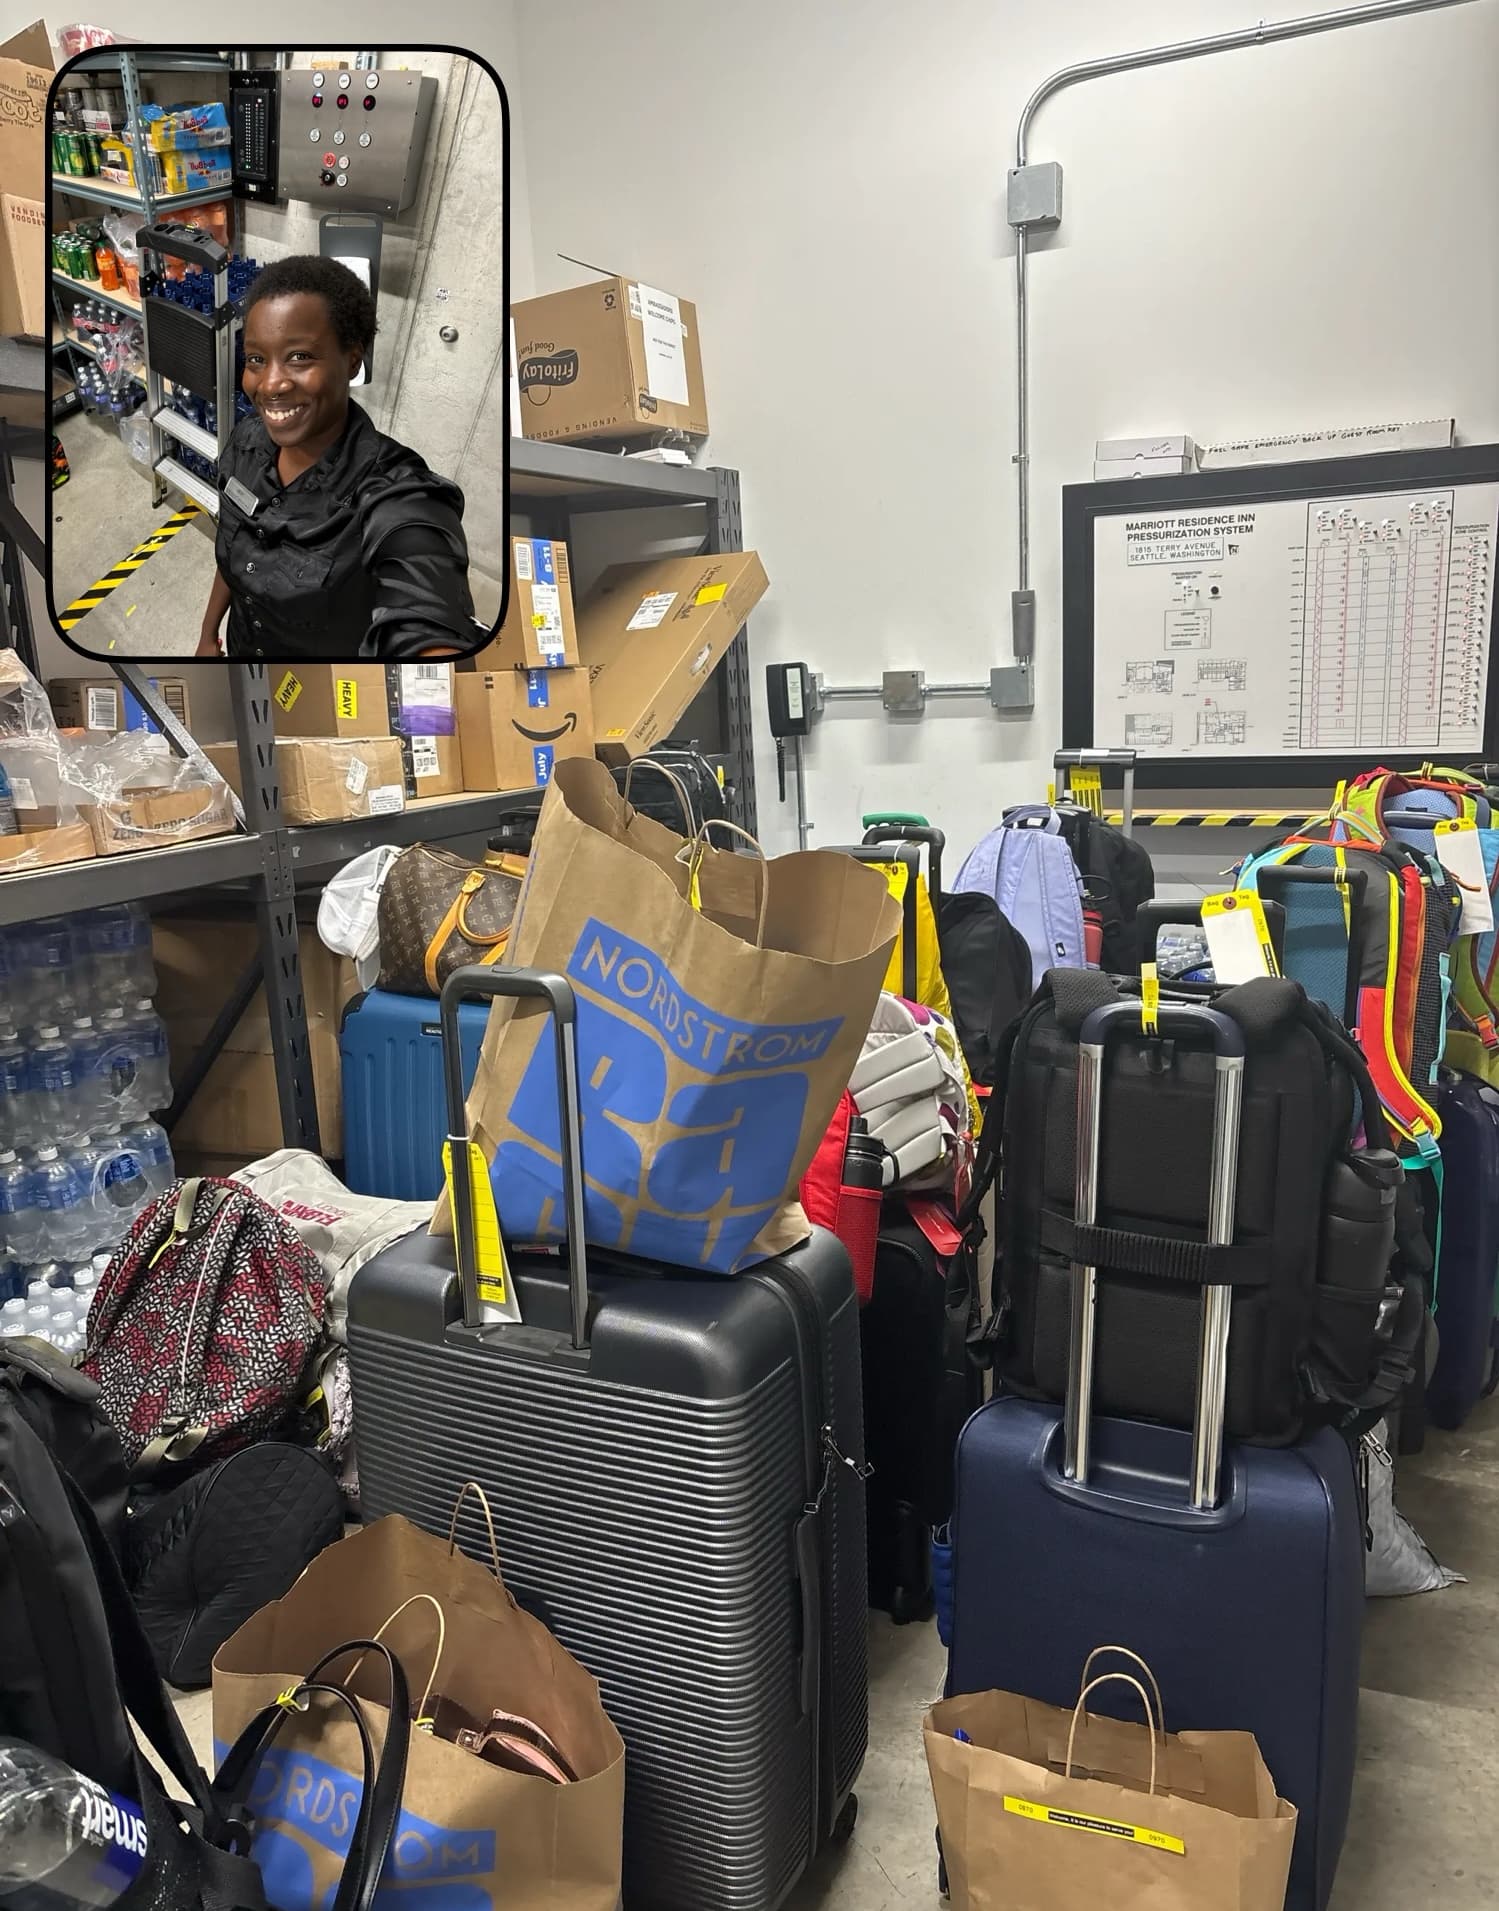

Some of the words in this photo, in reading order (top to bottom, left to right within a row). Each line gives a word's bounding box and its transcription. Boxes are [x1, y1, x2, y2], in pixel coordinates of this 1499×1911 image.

[536, 342, 555, 353] Good
[575, 416, 617, 428] VENDING
[1254, 438, 1299, 449] EMERGENCY
[1302, 435, 1323, 443] BACK
[1327, 432, 1338, 440] UP
[1341, 430, 1364, 440] GUEST
[1126, 519, 1176, 532] MARRIOTT
[1177, 514, 1236, 528] RESIDENCE
[1237, 512, 1256, 524] INN
[1127, 527, 1211, 542] PRESSURIZATION
[1213, 524, 1254, 537] SYSTEM
[1135, 546, 1153, 554] 1815
[1156, 543, 1181, 553] TERRY
[1184, 541, 1217, 551] AVENUE
[1170, 548, 1221, 560] WASHINGTON
[280, 676, 298, 707] HEAVY
[342, 681, 353, 717] HEAVY
[537, 752, 547, 780] July
[582, 936, 826, 1066] NORDSTROM
